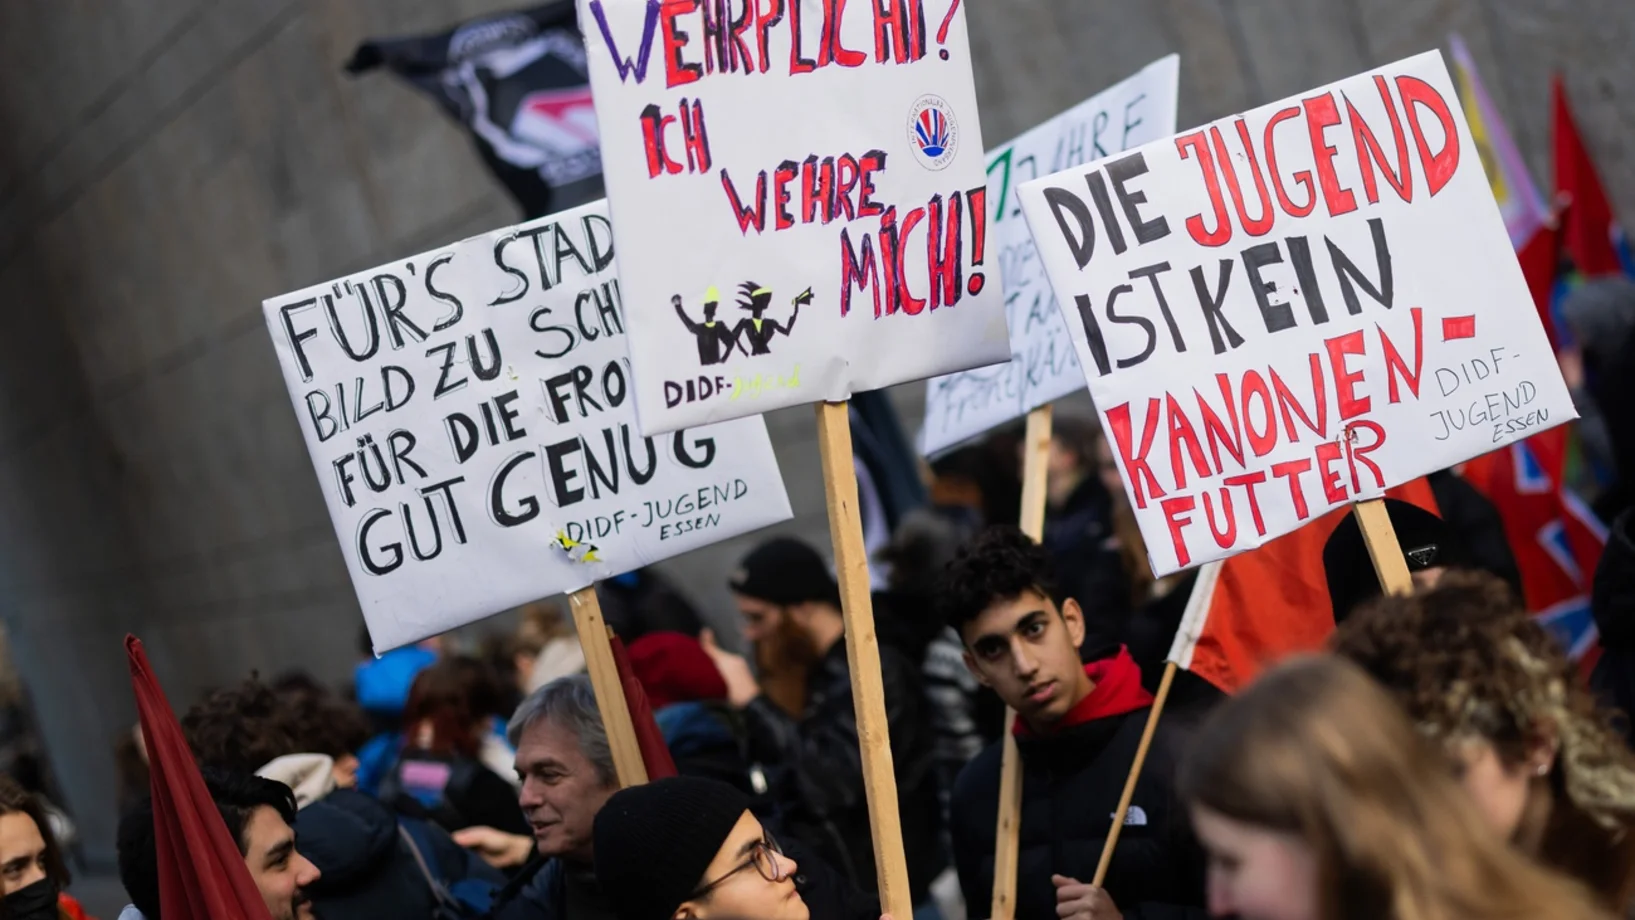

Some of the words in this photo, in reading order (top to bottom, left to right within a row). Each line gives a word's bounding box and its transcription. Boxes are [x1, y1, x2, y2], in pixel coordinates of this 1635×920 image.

[639, 97, 713, 179] ICH
[720, 149, 888, 237] WEHRE
[1043, 151, 1171, 270] DIE
[1175, 74, 1460, 248] JUGEND
[278, 251, 464, 383] FÜR'S
[839, 185, 987, 319] MICH!
[1074, 260, 1187, 376] IST
[1188, 217, 1394, 355] KEIN
[303, 365, 416, 443] BILD
[425, 327, 502, 400] ZU
[528, 277, 626, 359] SCH
[1428, 379, 1537, 442] JUGEND
[1433, 346, 1520, 398] DIDF-
[1491, 407, 1550, 443] ESSEN
[332, 427, 427, 508] FÜR
[444, 389, 526, 465] DIE
[540, 356, 632, 426] FRO
[1160, 419, 1388, 567] FUTTER
[356, 476, 468, 577] GUT
[486, 422, 717, 528] GENUG
[566, 479, 749, 546] DIDF-JUGEND
[658, 513, 722, 542] ESSEN
